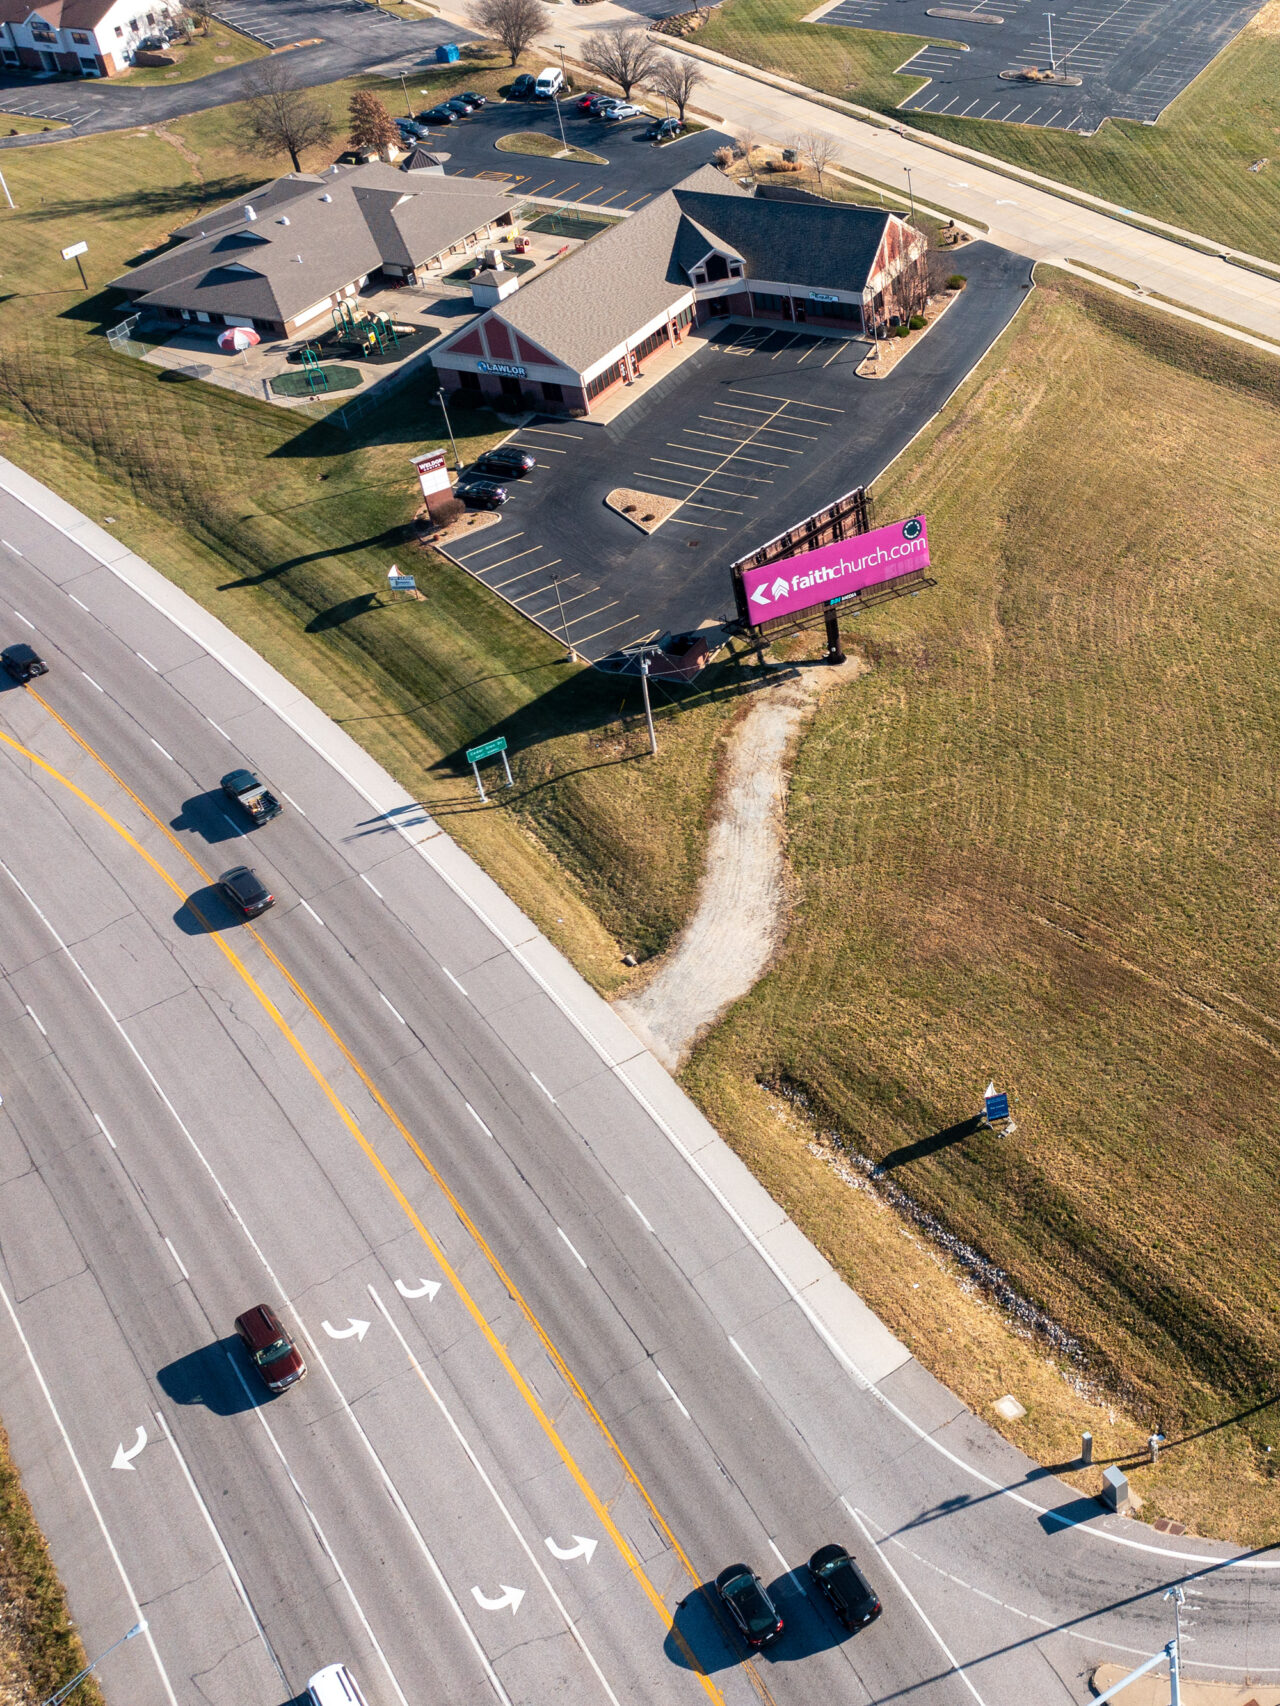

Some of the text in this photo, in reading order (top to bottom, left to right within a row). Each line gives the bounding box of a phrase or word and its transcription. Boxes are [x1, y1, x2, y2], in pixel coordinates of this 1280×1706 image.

[486, 363, 526, 375] LAWLOR
[418, 458, 444, 470] WELDON
[791, 537, 926, 591] faithchurch.com
